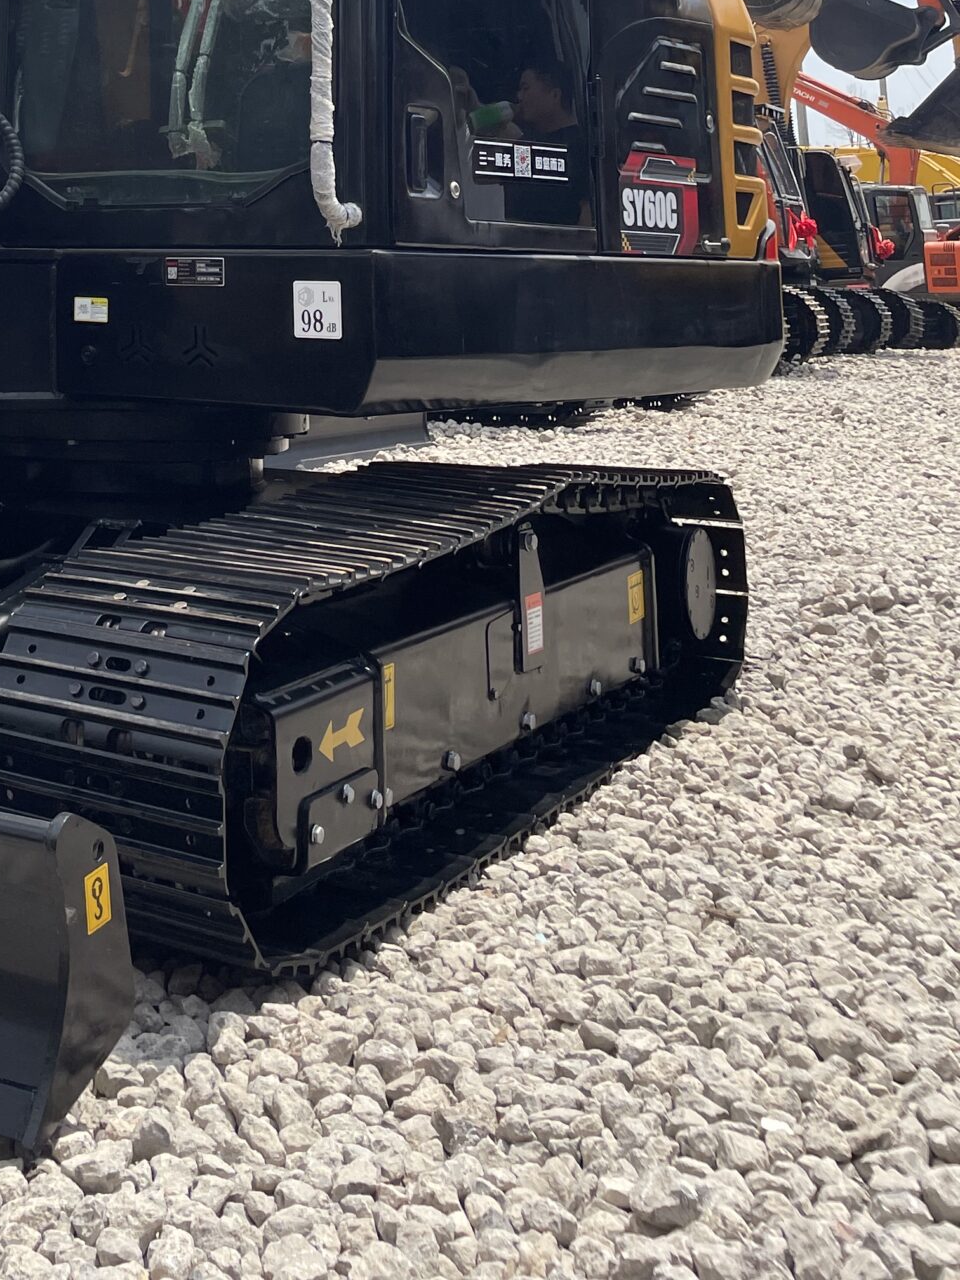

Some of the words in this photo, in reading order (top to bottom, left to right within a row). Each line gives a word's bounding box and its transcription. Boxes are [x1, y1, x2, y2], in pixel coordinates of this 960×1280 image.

[622, 187, 677, 229] SY60C
[301, 309, 323, 333] 98
[326, 323, 336, 333] dB
